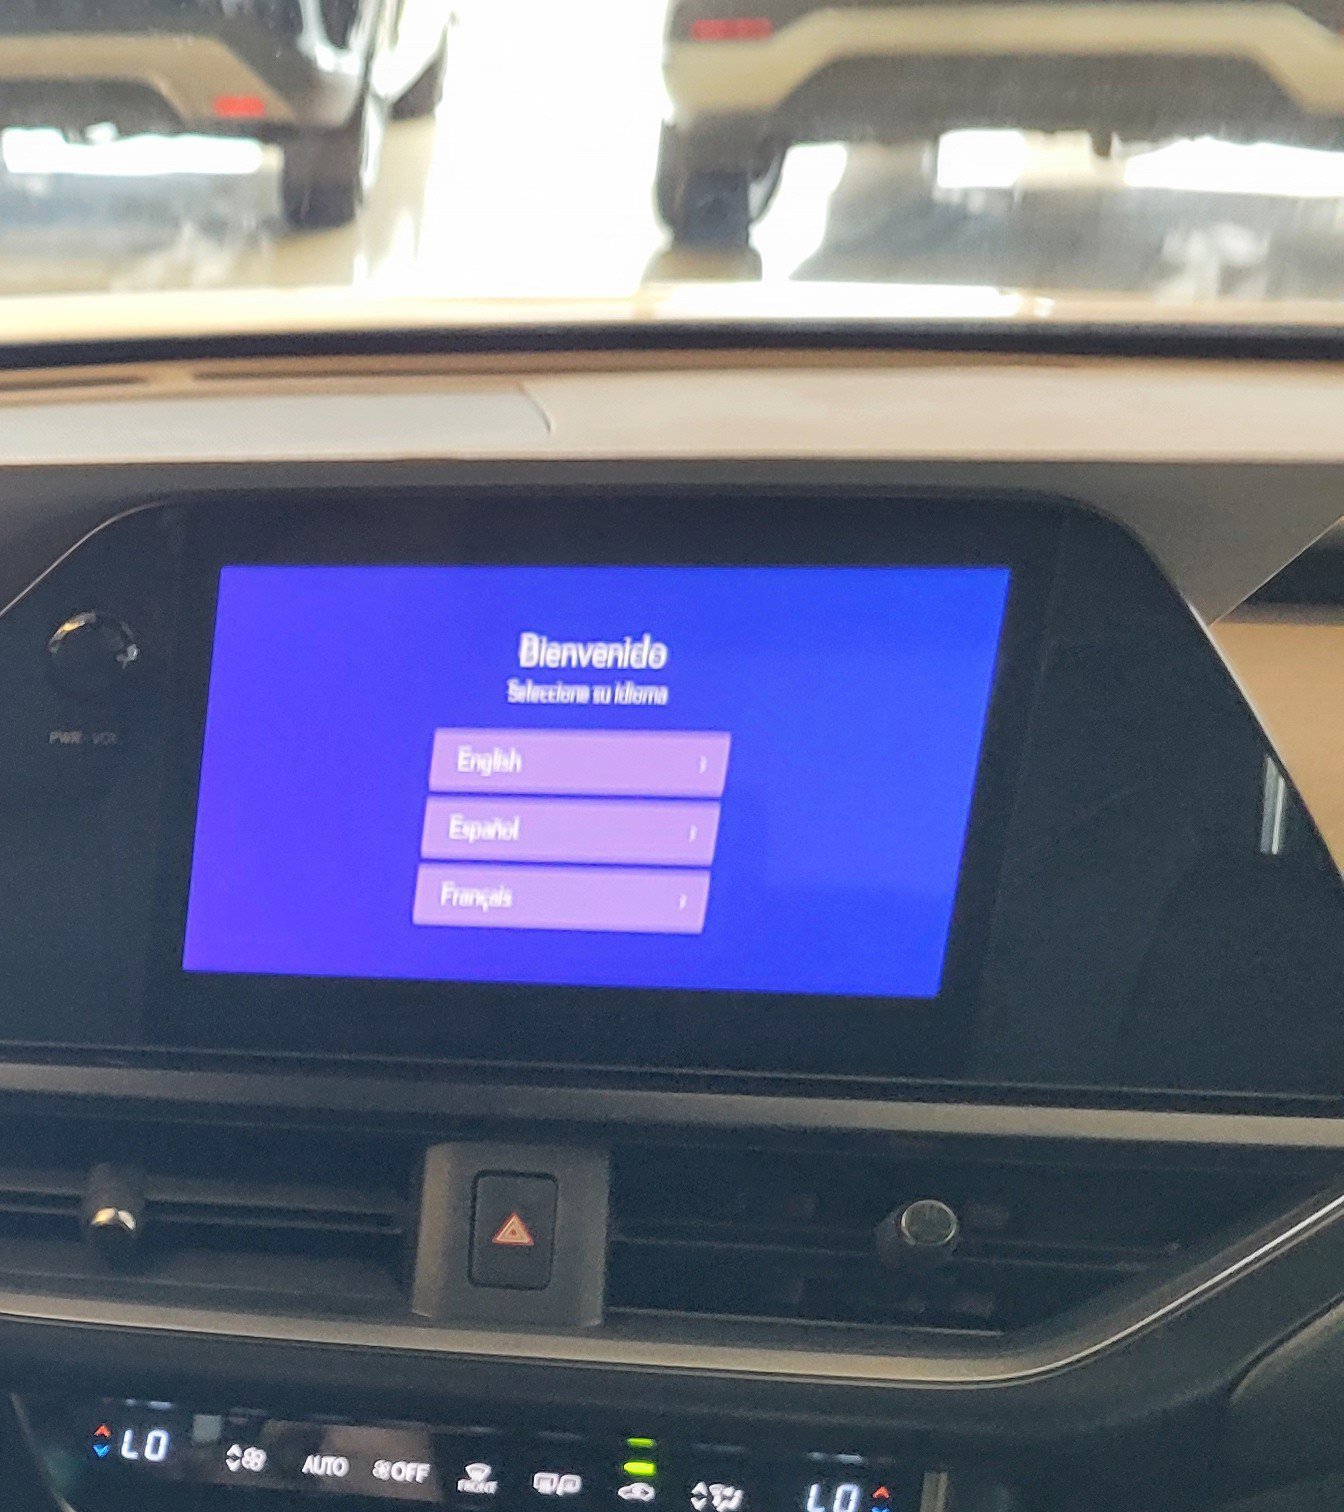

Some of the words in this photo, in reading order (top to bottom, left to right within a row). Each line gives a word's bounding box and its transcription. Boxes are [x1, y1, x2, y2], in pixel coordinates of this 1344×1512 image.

[519, 632, 667, 669] Bienvenido
[507, 678, 590, 704] Seleccione
[592, 685, 612, 705] su
[614, 681, 668, 706] idioma
[457, 746, 522, 776] English
[449, 814, 520, 843] Español
[441, 881, 512, 911] Français
[120, 1428, 170, 1462] LO
[301, 1453, 351, 1478] AUTO
[391, 1460, 431, 1484] OFF
[456, 1478, 499, 1495] FRONT
